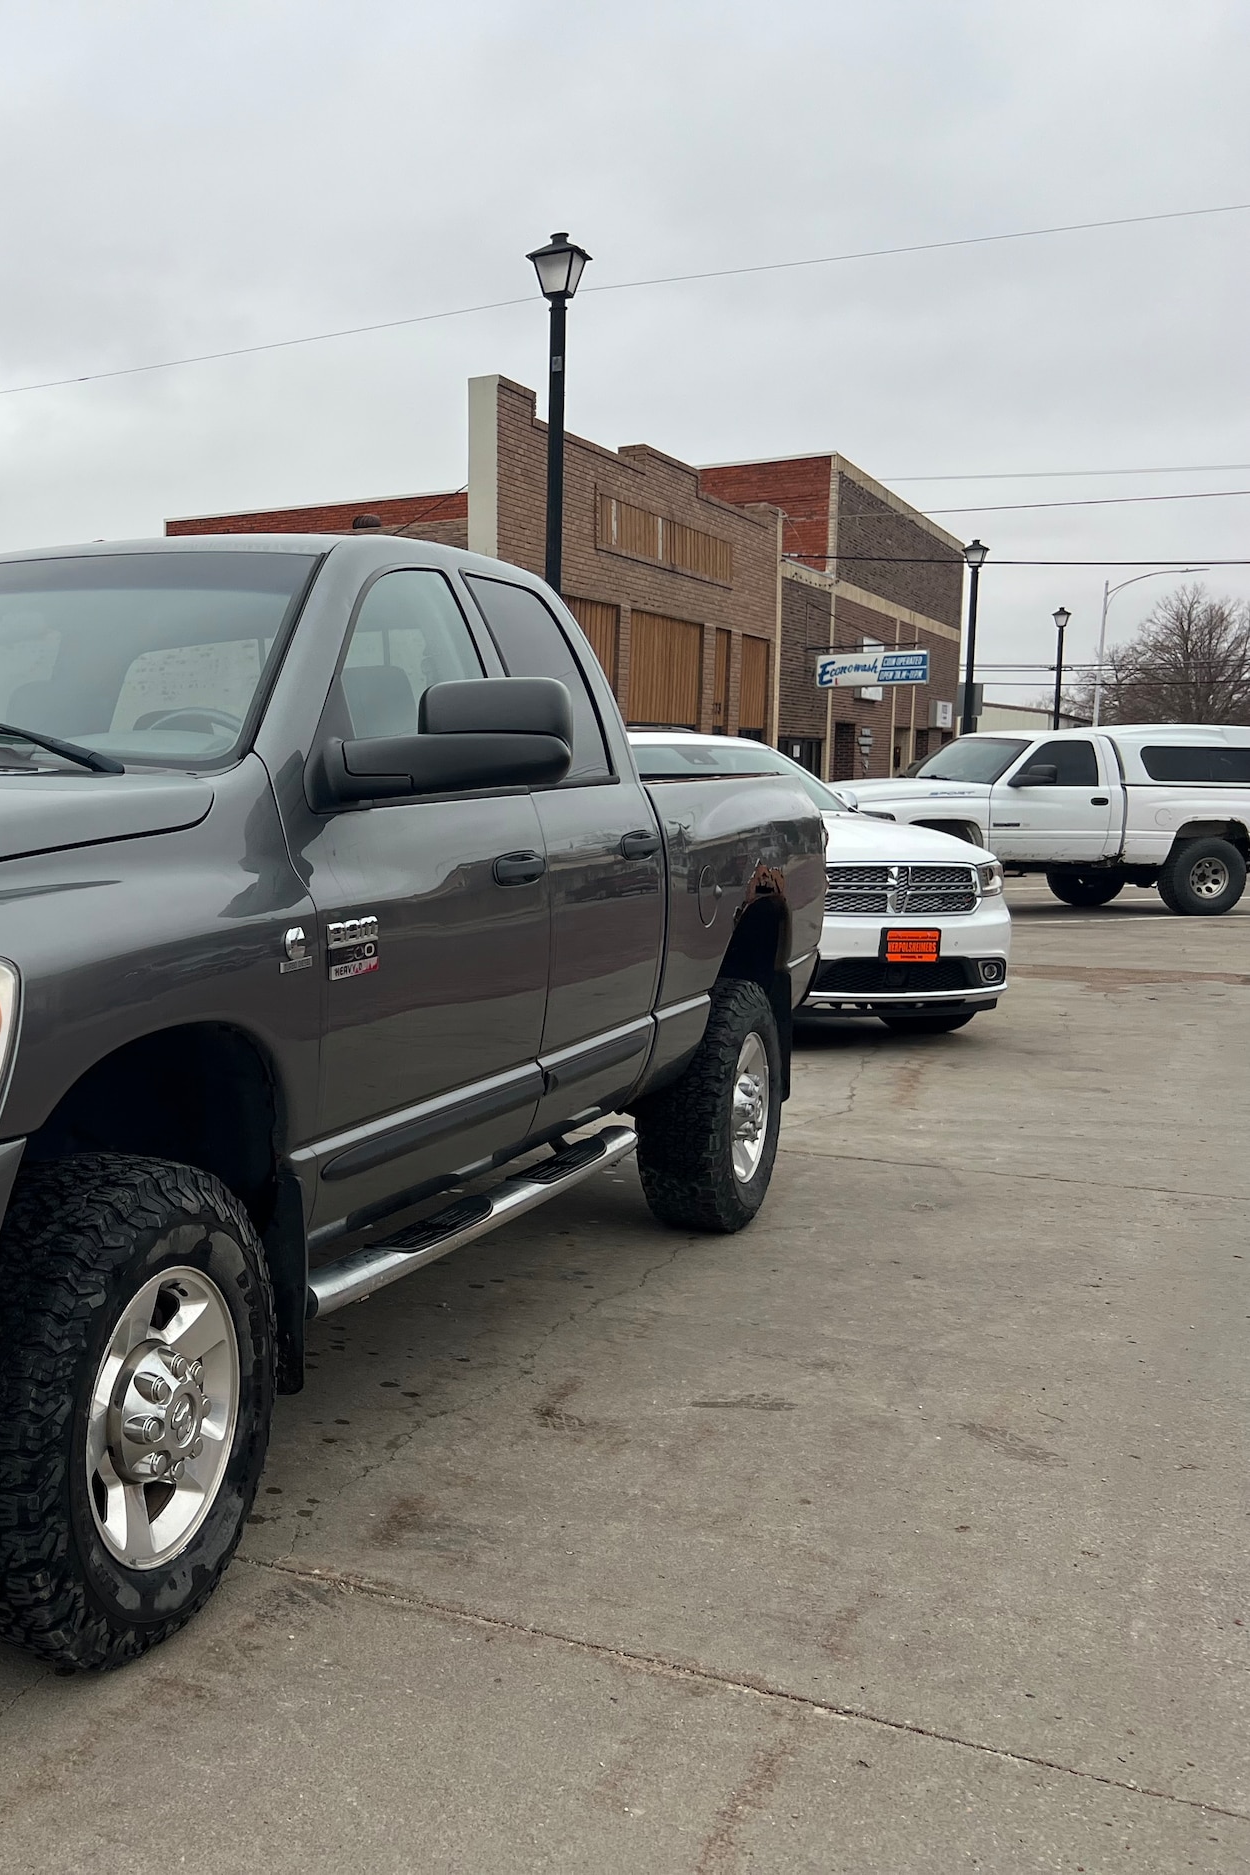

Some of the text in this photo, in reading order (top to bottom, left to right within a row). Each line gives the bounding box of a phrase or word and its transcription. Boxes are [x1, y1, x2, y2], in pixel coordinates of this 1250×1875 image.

[818, 658, 878, 685] Econowash
[896, 656, 923, 665] OPERATED
[327, 916, 379, 945] RAM
